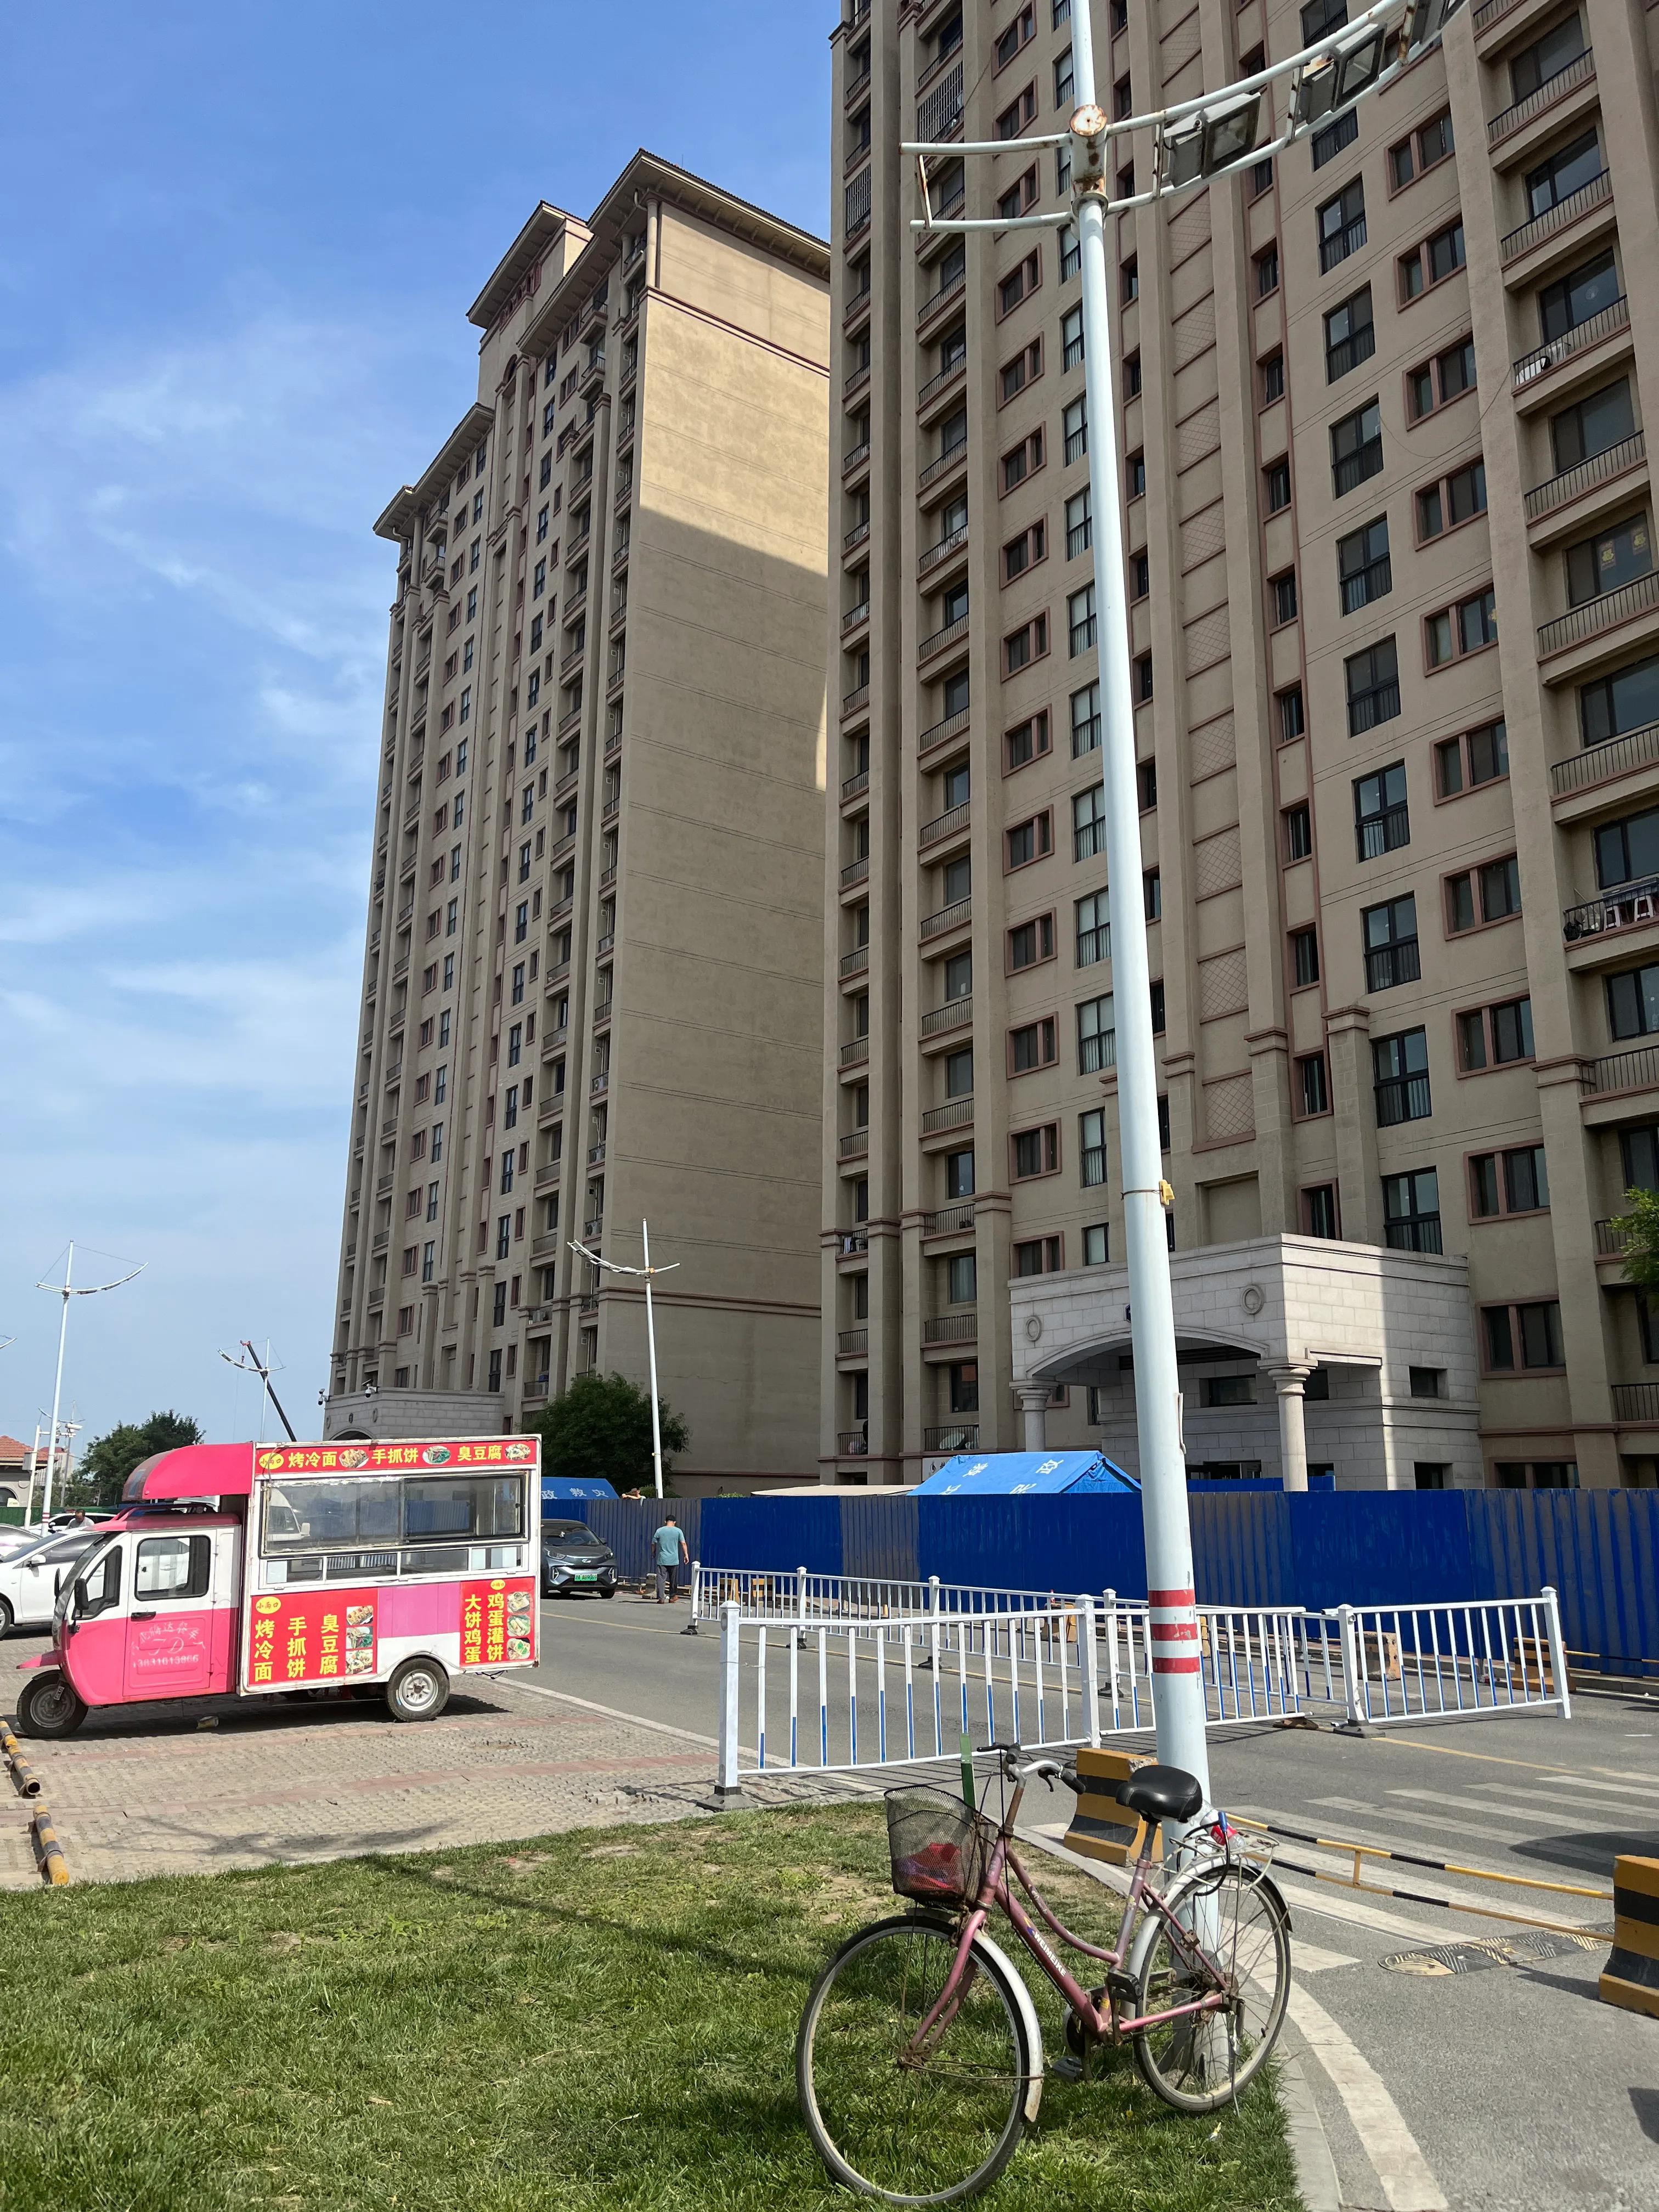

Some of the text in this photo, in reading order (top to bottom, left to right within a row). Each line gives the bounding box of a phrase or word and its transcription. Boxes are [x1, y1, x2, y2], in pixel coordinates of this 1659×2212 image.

[288, 1451, 337, 1468] 烤冷面
[371, 1448, 419, 1465] 手抓饼
[457, 1445, 503, 1462] 臭豆腐
[254, 1619, 275, 1681] 烤冷面
[287, 1616, 307, 1678] 手抓饼
[319, 1613, 340, 1675] 臭豆腐
[464, 1594, 482, 1663] 大饼鸡蛋
[487, 1592, 504, 1661] 鸡蛋灌饼
[1034, 1931, 1066, 1977] WEIMEIKE
